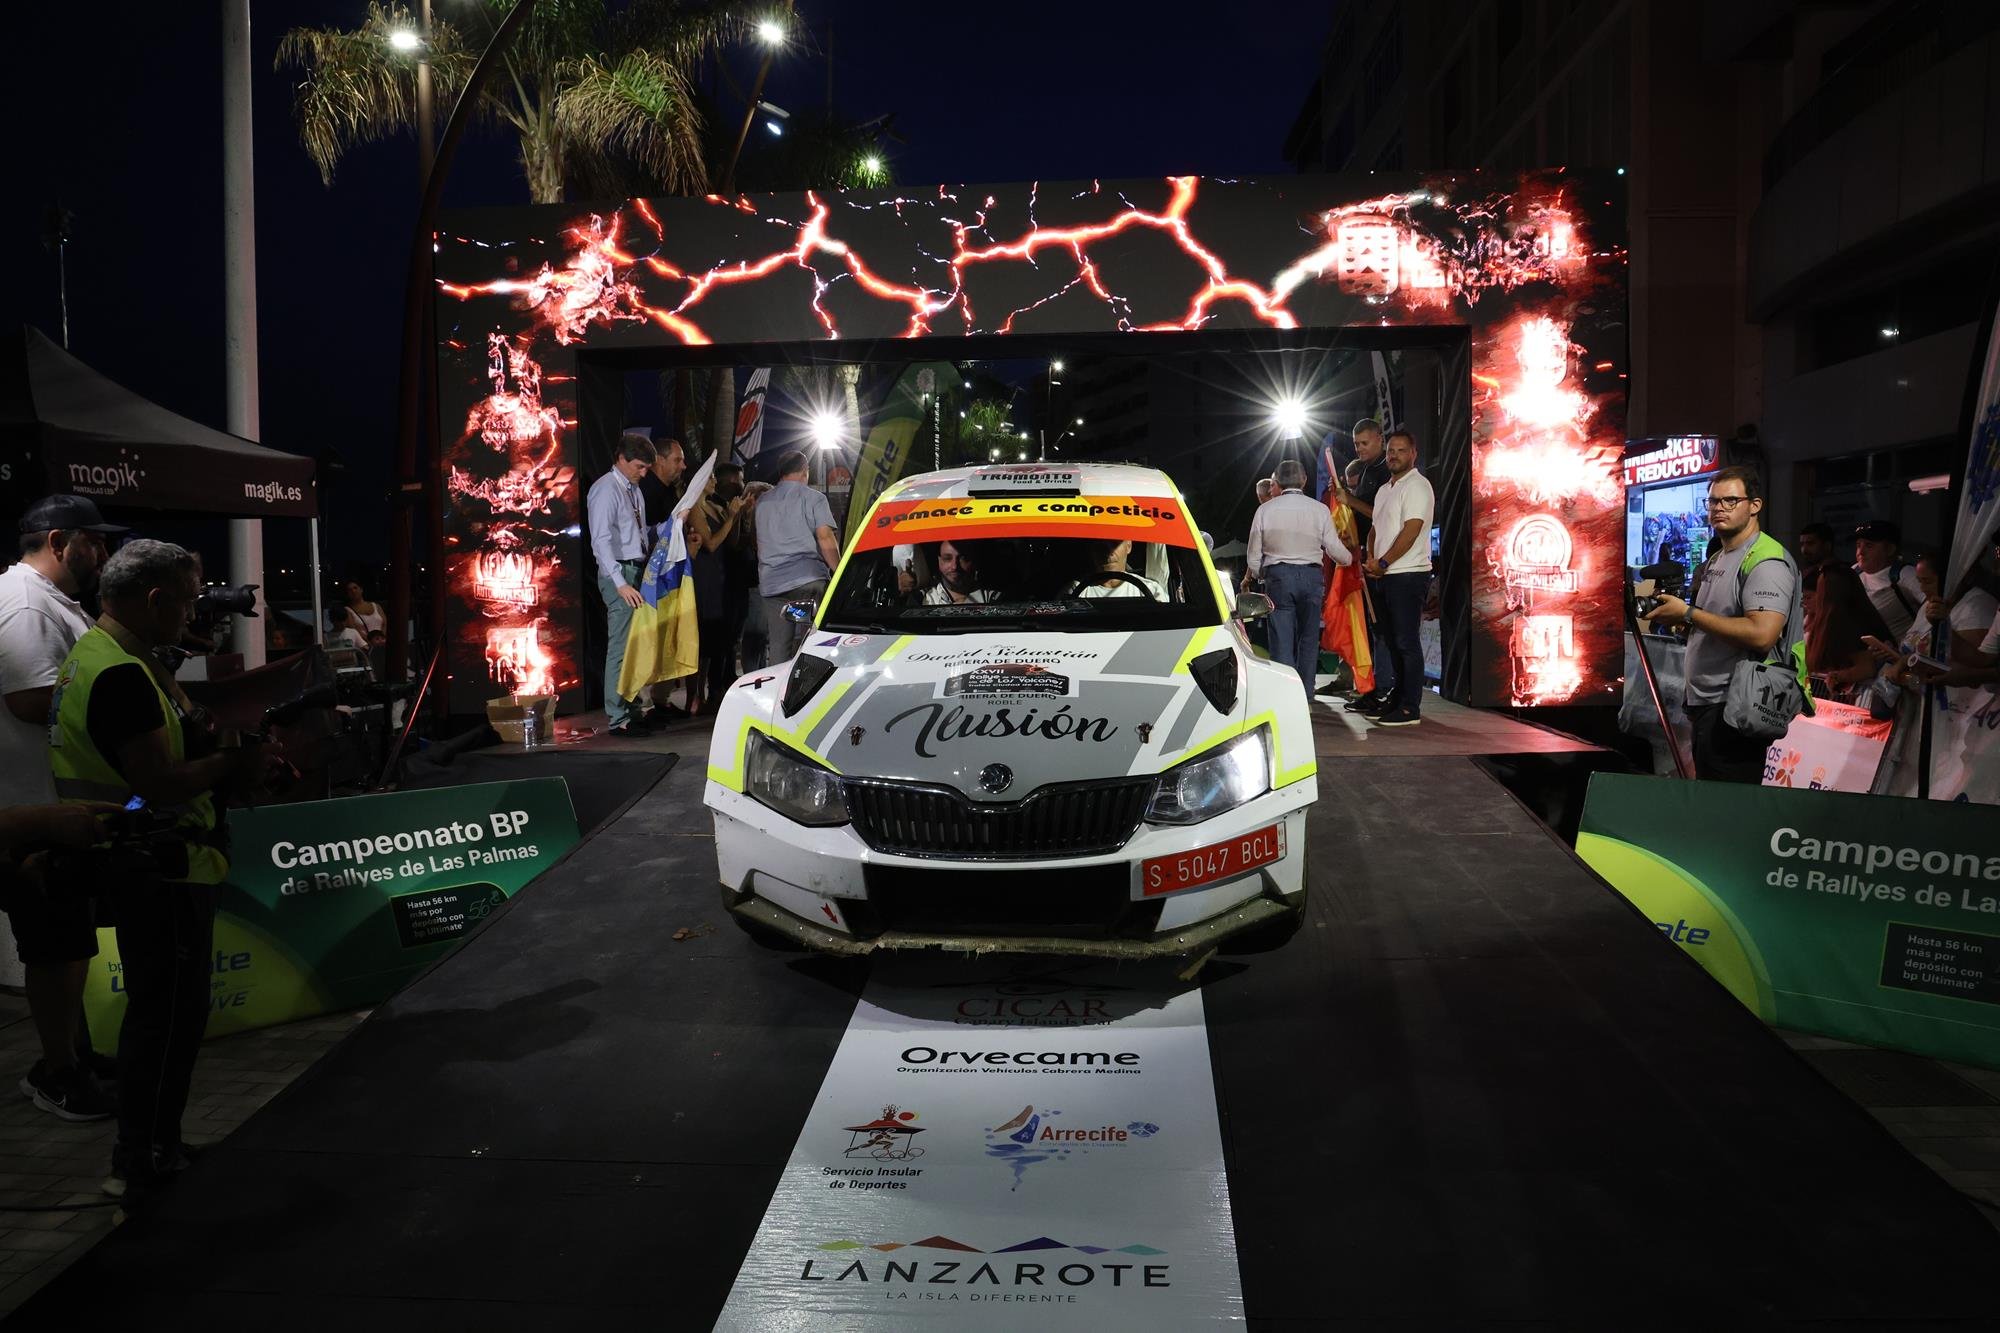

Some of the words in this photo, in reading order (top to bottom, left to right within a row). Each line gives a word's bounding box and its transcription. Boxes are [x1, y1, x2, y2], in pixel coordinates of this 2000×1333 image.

[68, 461, 139, 491] magik
[1636, 454, 1702, 483] REDUCTO
[244, 481, 302, 502] magik.es
[877, 505, 973, 528] gamace
[989, 502, 1023, 513] mc
[1037, 502, 1176, 520] competicio
[906, 648, 983, 662] David
[944, 658, 990, 668] RIBERA
[1015, 657, 1061, 665] DUERO
[271, 821, 484, 869] Campeonato
[489, 810, 530, 838] BP
[1150, 864, 1162, 887] S
[1178, 848, 1229, 882] 5047
[1242, 835, 1273, 865] BCL
[280, 877, 310, 896] de
[314, 865, 394, 891] Rallyes
[399, 860, 425, 878] de
[429, 854, 465, 873] Las
[468, 844, 540, 867] Palmas
[1766, 867, 1800, 888] de
[1806, 870, 1906, 902] Rallyes
[1914, 884, 1952, 908] de
[407, 899, 431, 909] Hasta
[432, 896, 443, 905] 56
[444, 895, 457, 903] km
[429, 908, 443, 917] por
[449, 913, 464, 922] con
[1907, 934, 1942, 948] Hasta
[1945, 939, 1961, 950] 56
[1963, 942, 1983, 953] km
[1934, 952, 1956, 962] por
[1903, 970, 1919, 982] bp
[1960, 968, 1983, 979] con
[957, 998, 1114, 1018] CICAR
[1021, 1017, 1077, 1026] Islands
[901, 1046, 1141, 1066] Orvecame
[1095, 1067, 1142, 1075] Medina
[1040, 1126, 1128, 1142] Arrecife
[822, 1166, 874, 1176] Servicio
[877, 1166, 924, 1177] Insular
[829, 1180, 845, 1189] de
[849, 1179, 908, 1191] Deportes
[800, 1259, 1172, 1288] LANZAROTE
[886, 1291, 908, 1300] LA
[918, 1292, 960, 1301] ISLA
[970, 1293, 1078, 1303] DIFERENTE
